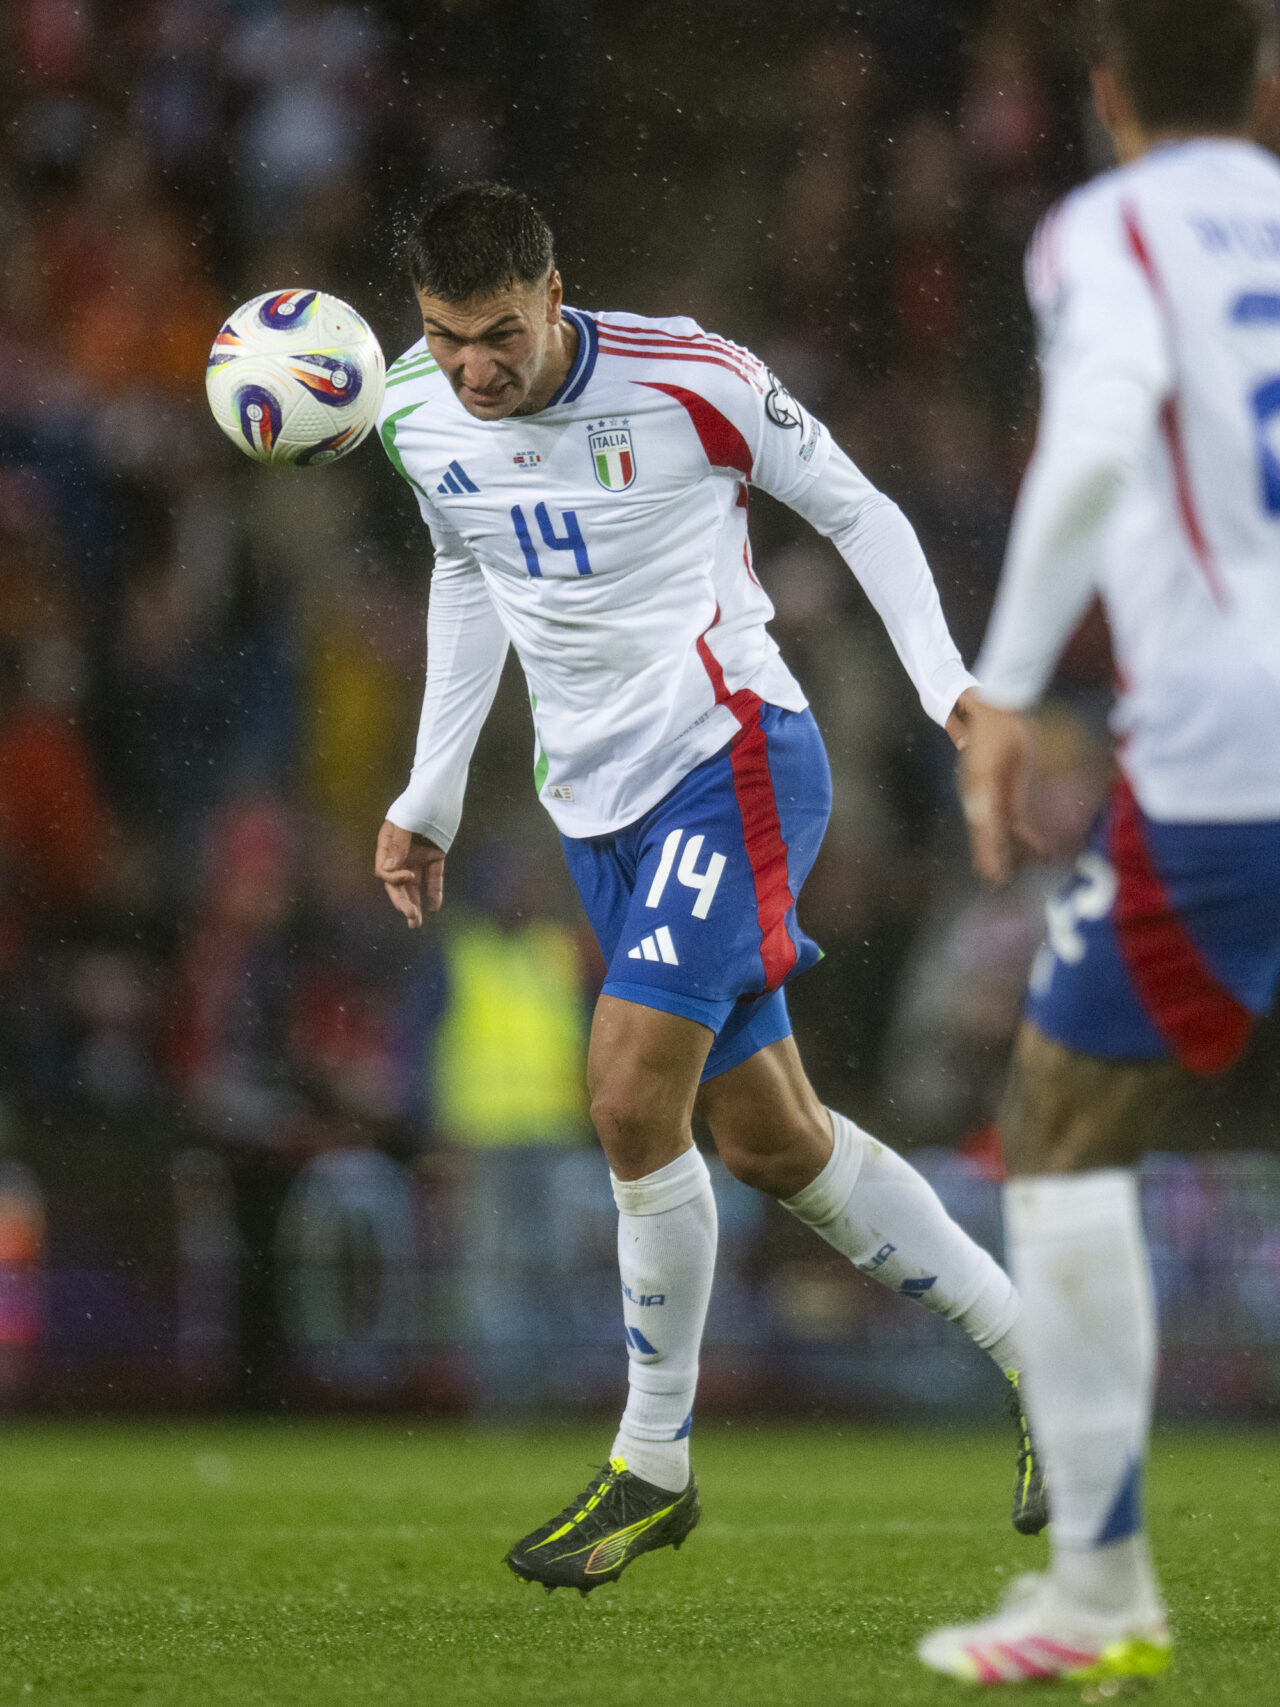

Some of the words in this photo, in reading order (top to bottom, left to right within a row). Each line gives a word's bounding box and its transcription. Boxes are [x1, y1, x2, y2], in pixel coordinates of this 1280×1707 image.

[592, 433, 628, 449] ITALIA
[510, 501, 593, 577] 14
[645, 828, 728, 920] 14
